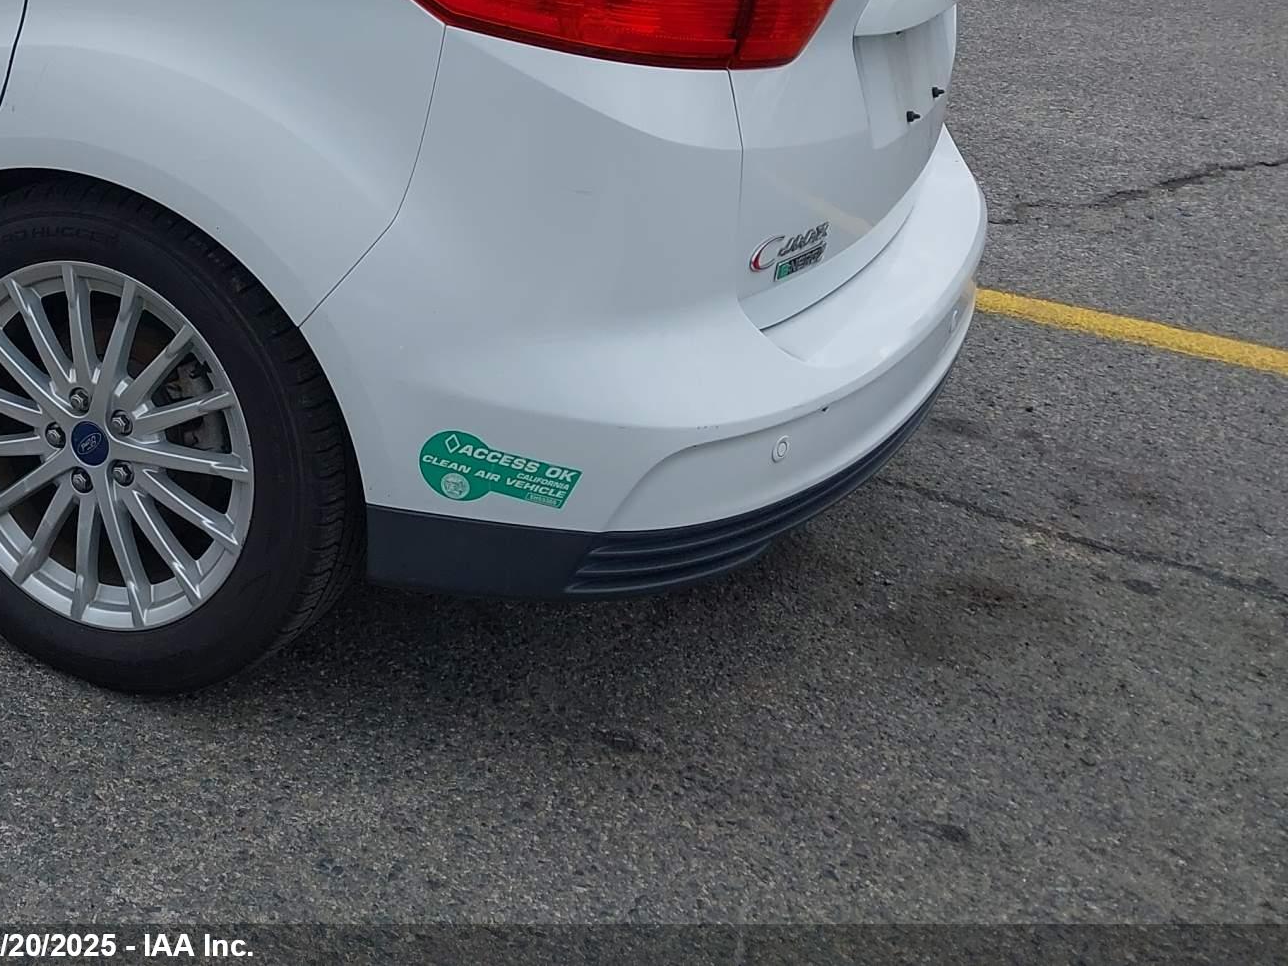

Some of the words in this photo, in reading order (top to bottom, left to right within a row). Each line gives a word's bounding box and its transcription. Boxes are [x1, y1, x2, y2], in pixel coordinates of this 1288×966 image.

[422, 454, 472, 474] CLEAN
[474, 469, 501, 482] AIR
[506, 477, 568, 499] VEHICLE
[457, 444, 540, 473] ACCESS
[545, 466, 579, 483] OK
[516, 473, 570, 491] CALIFORNIA
